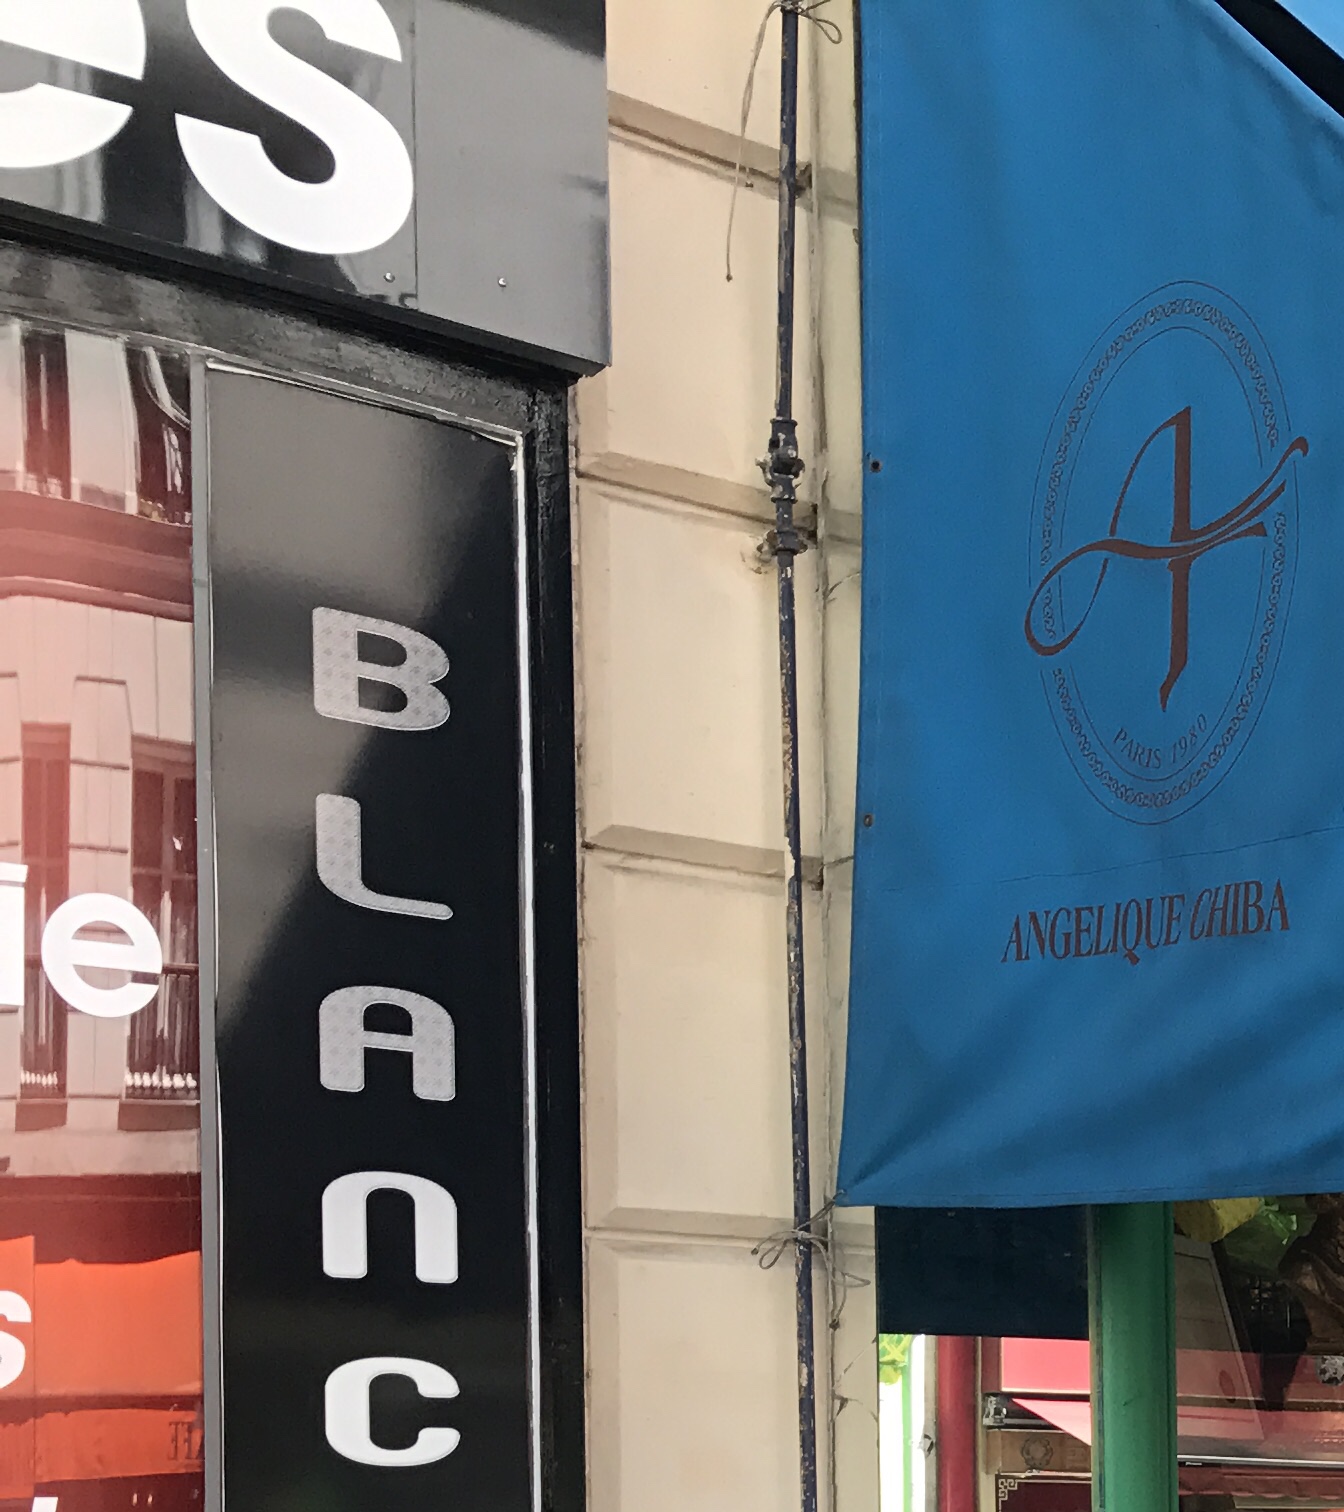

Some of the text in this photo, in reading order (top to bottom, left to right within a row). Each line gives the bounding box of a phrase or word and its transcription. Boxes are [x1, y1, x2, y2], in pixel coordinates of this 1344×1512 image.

[1112, 712, 1208, 770] PARIS 1980
[1001, 877, 1290, 966] ANGELIQUE CHIBA
